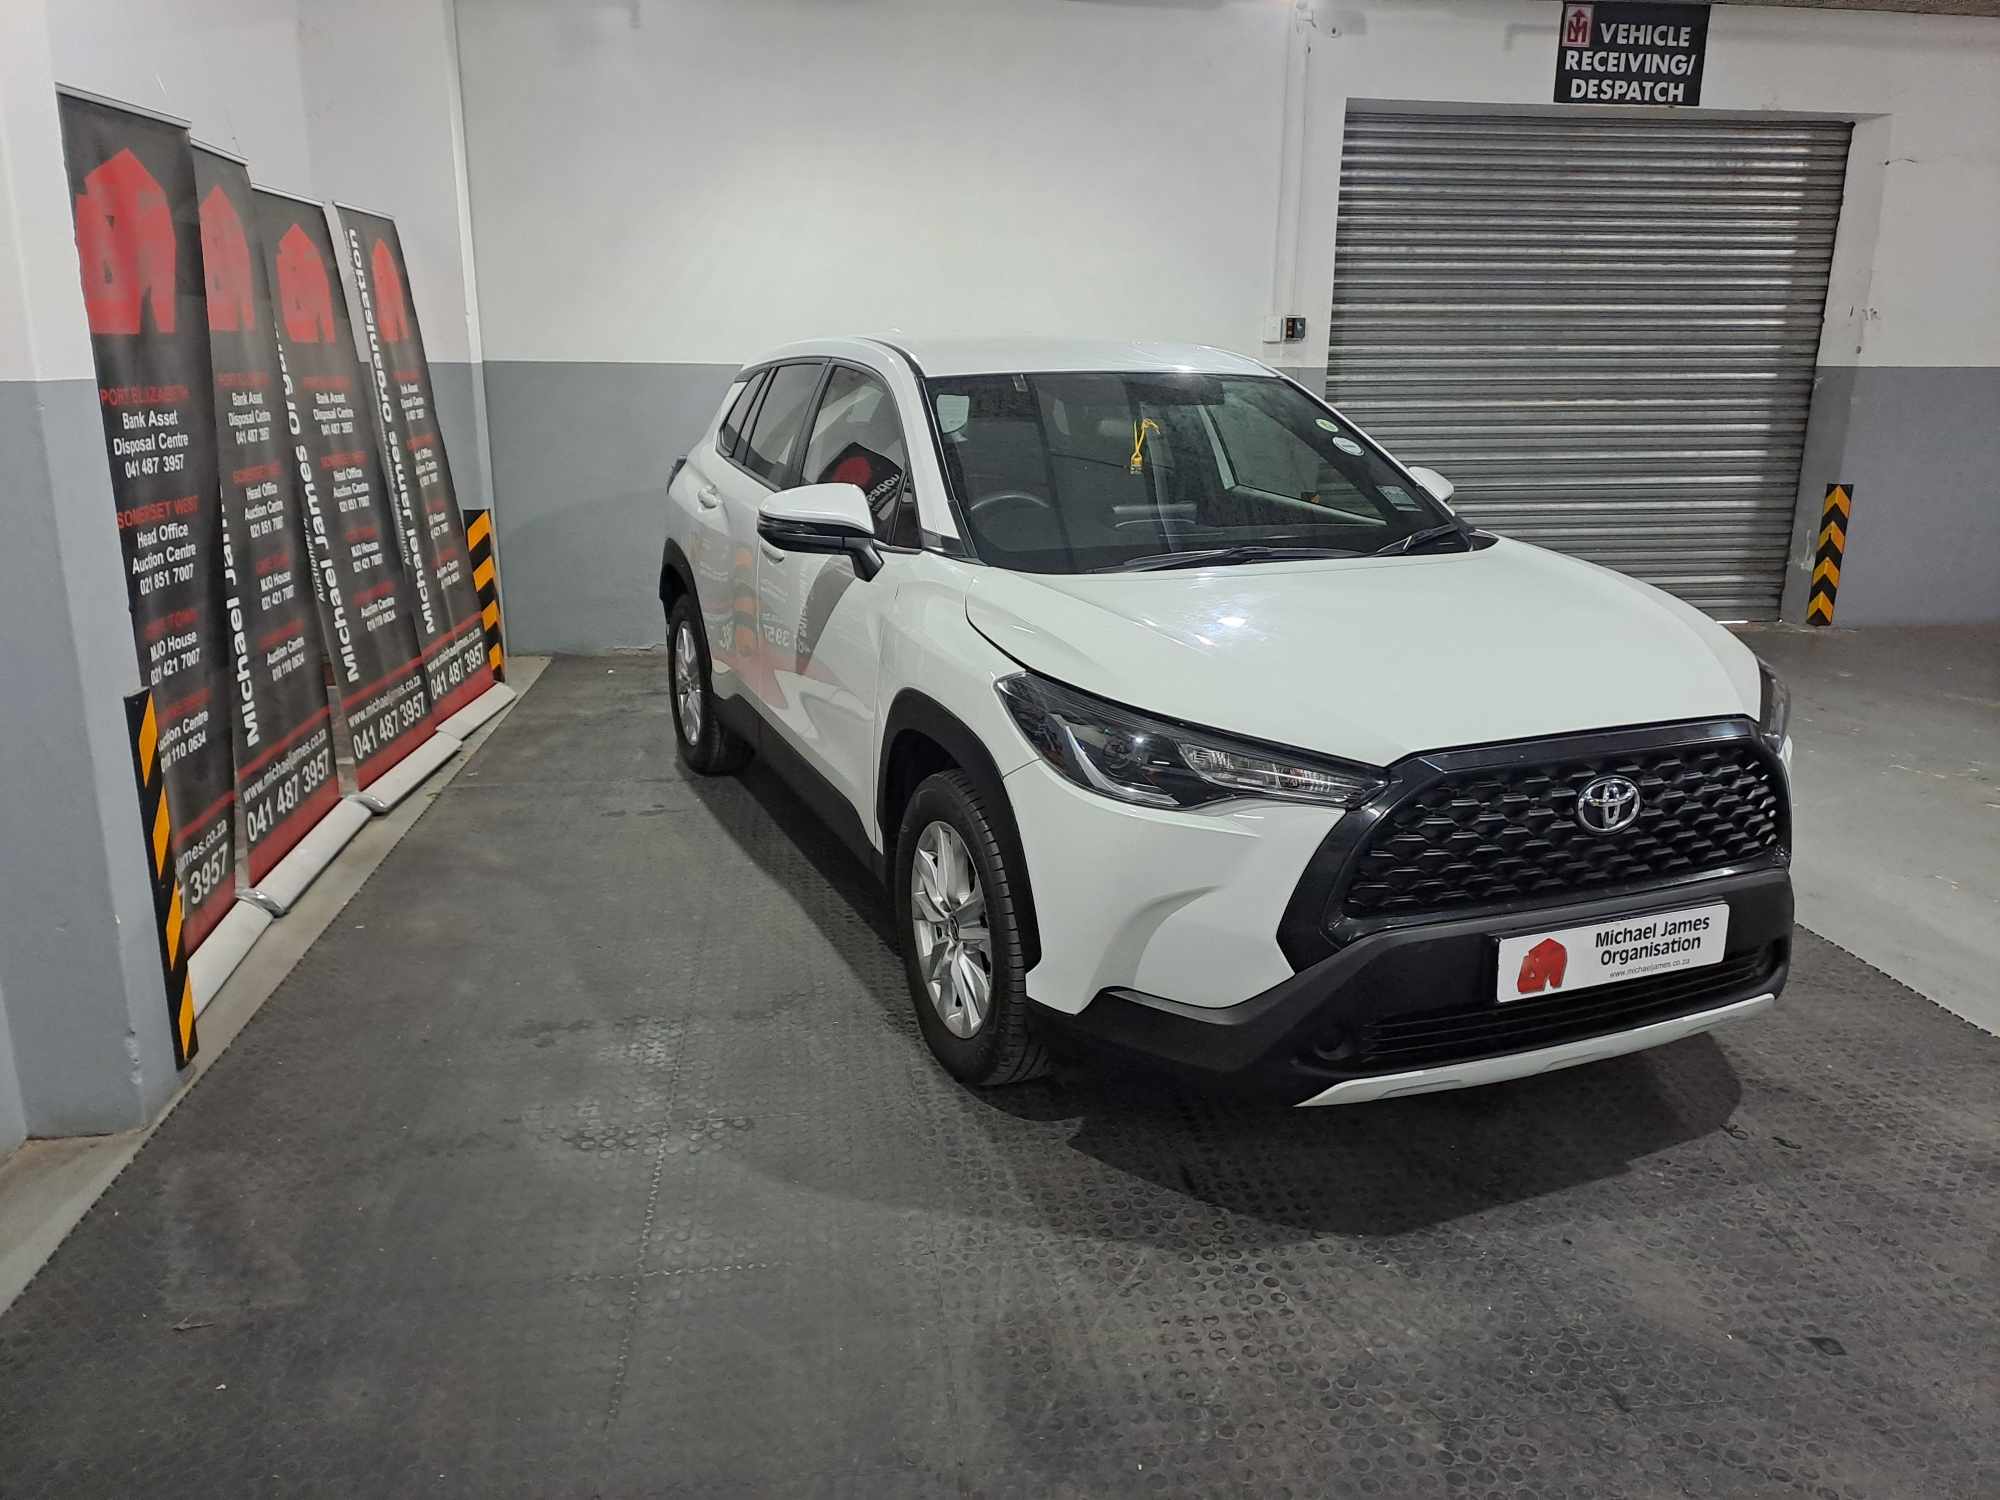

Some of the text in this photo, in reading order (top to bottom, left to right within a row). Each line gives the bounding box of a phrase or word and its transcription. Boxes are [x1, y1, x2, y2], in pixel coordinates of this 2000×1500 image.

[1600, 23, 1691, 47] VEHICLE
[1565, 50, 1697, 76] RECEIVING/
[1570, 78, 1685, 103] DESPATCH
[348, 229, 393, 422] Organisation
[122, 409, 178, 430] Bank Asset
[113, 432, 189, 457] Disposal Centre
[125, 453, 184, 478] 041 487 3957
[388, 431, 413, 521] James
[136, 523, 189, 549] Head Office
[132, 543, 197, 575] Auction Centre
[296, 445, 359, 683] Michael James
[140, 563, 194, 596] 021 851 7007
[406, 529, 435, 634] Michael
[167, 631, 197, 652] House
[163, 657, 178, 676] 421
[181, 647, 201, 669] 7007
[227, 597, 259, 748] Michael
[430, 642, 485, 700] 041 487 3957
[182, 710, 209, 734] Centre
[353, 691, 425, 760] 041 487 3957
[247, 747, 329, 842] 041 487 3957
[190, 842, 228, 905] 3957
[1595, 916, 1710, 948] Michael James
[1600, 935, 1701, 967] Organisation
